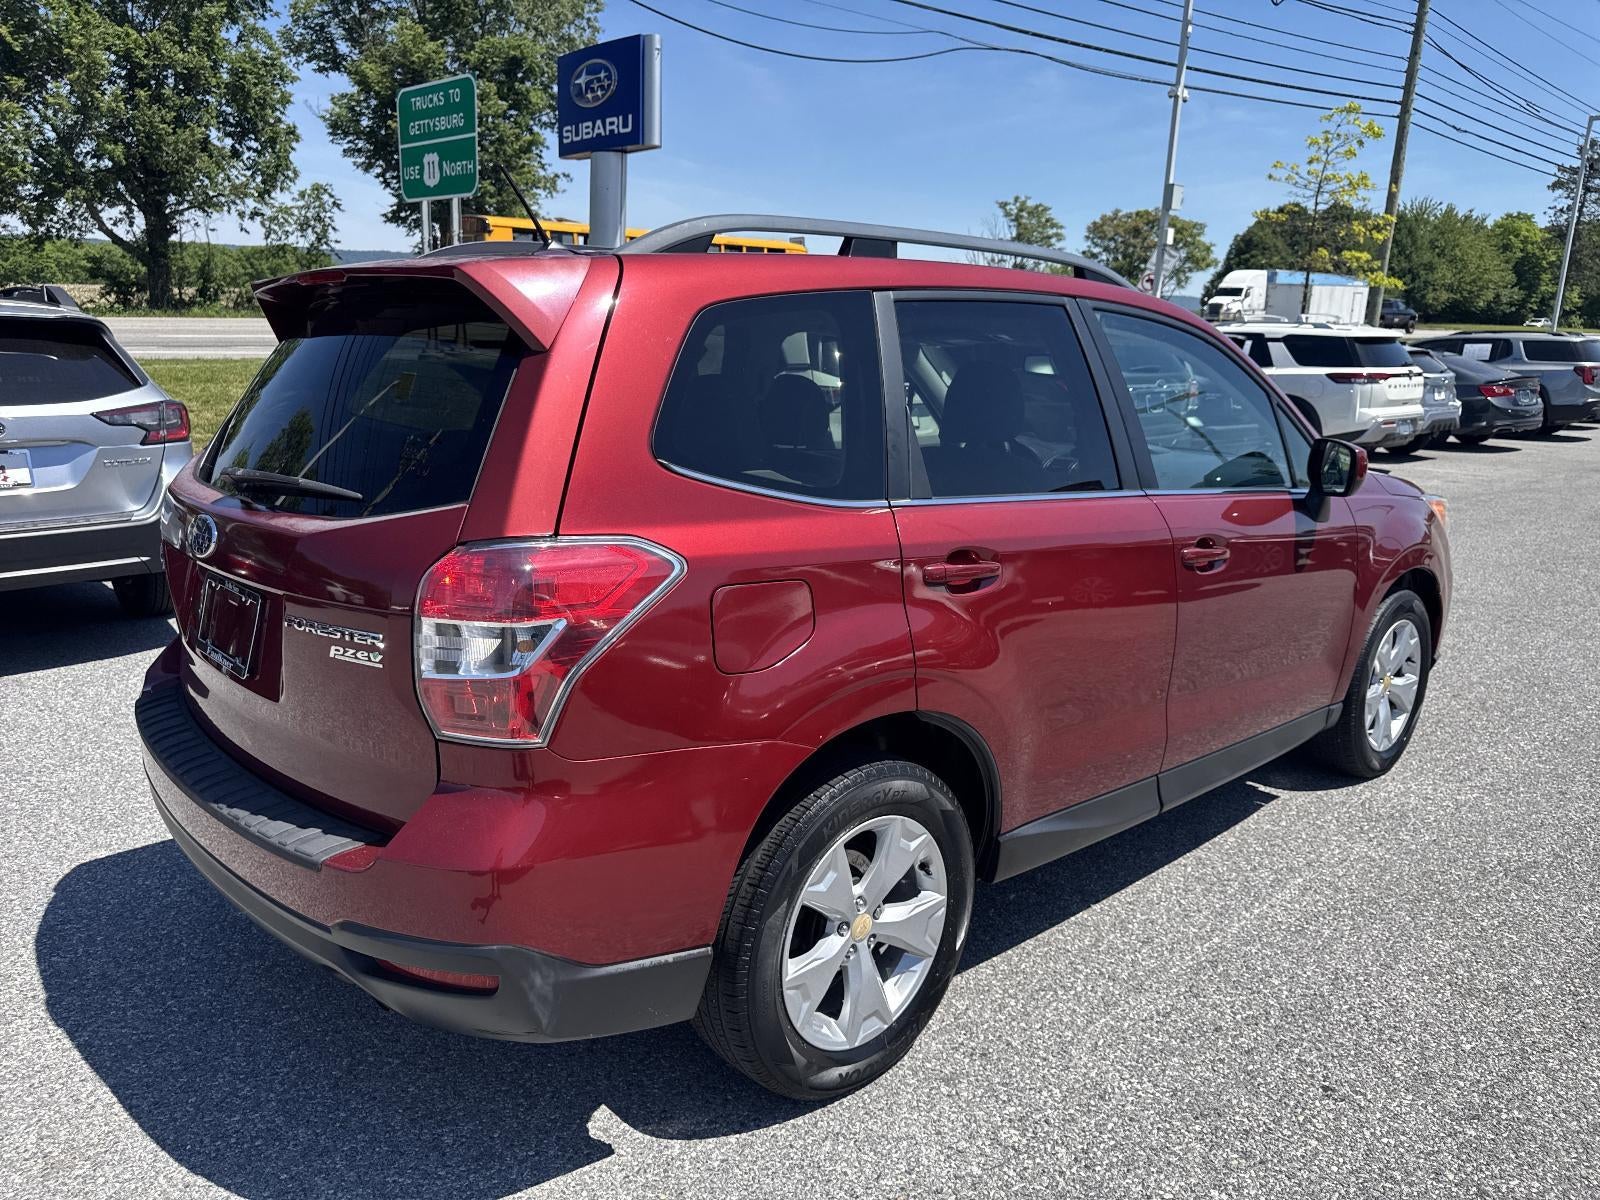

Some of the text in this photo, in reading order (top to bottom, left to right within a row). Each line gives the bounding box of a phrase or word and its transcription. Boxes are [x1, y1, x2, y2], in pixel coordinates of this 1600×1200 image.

[411, 88, 461, 111] TRUCKS TO
[409, 113, 465, 135] GETTYSBURG
[562, 114, 633, 144] SUBARU
[404, 160, 474, 180] USE 11 NORTH
[284, 614, 384, 648] FORESTER
